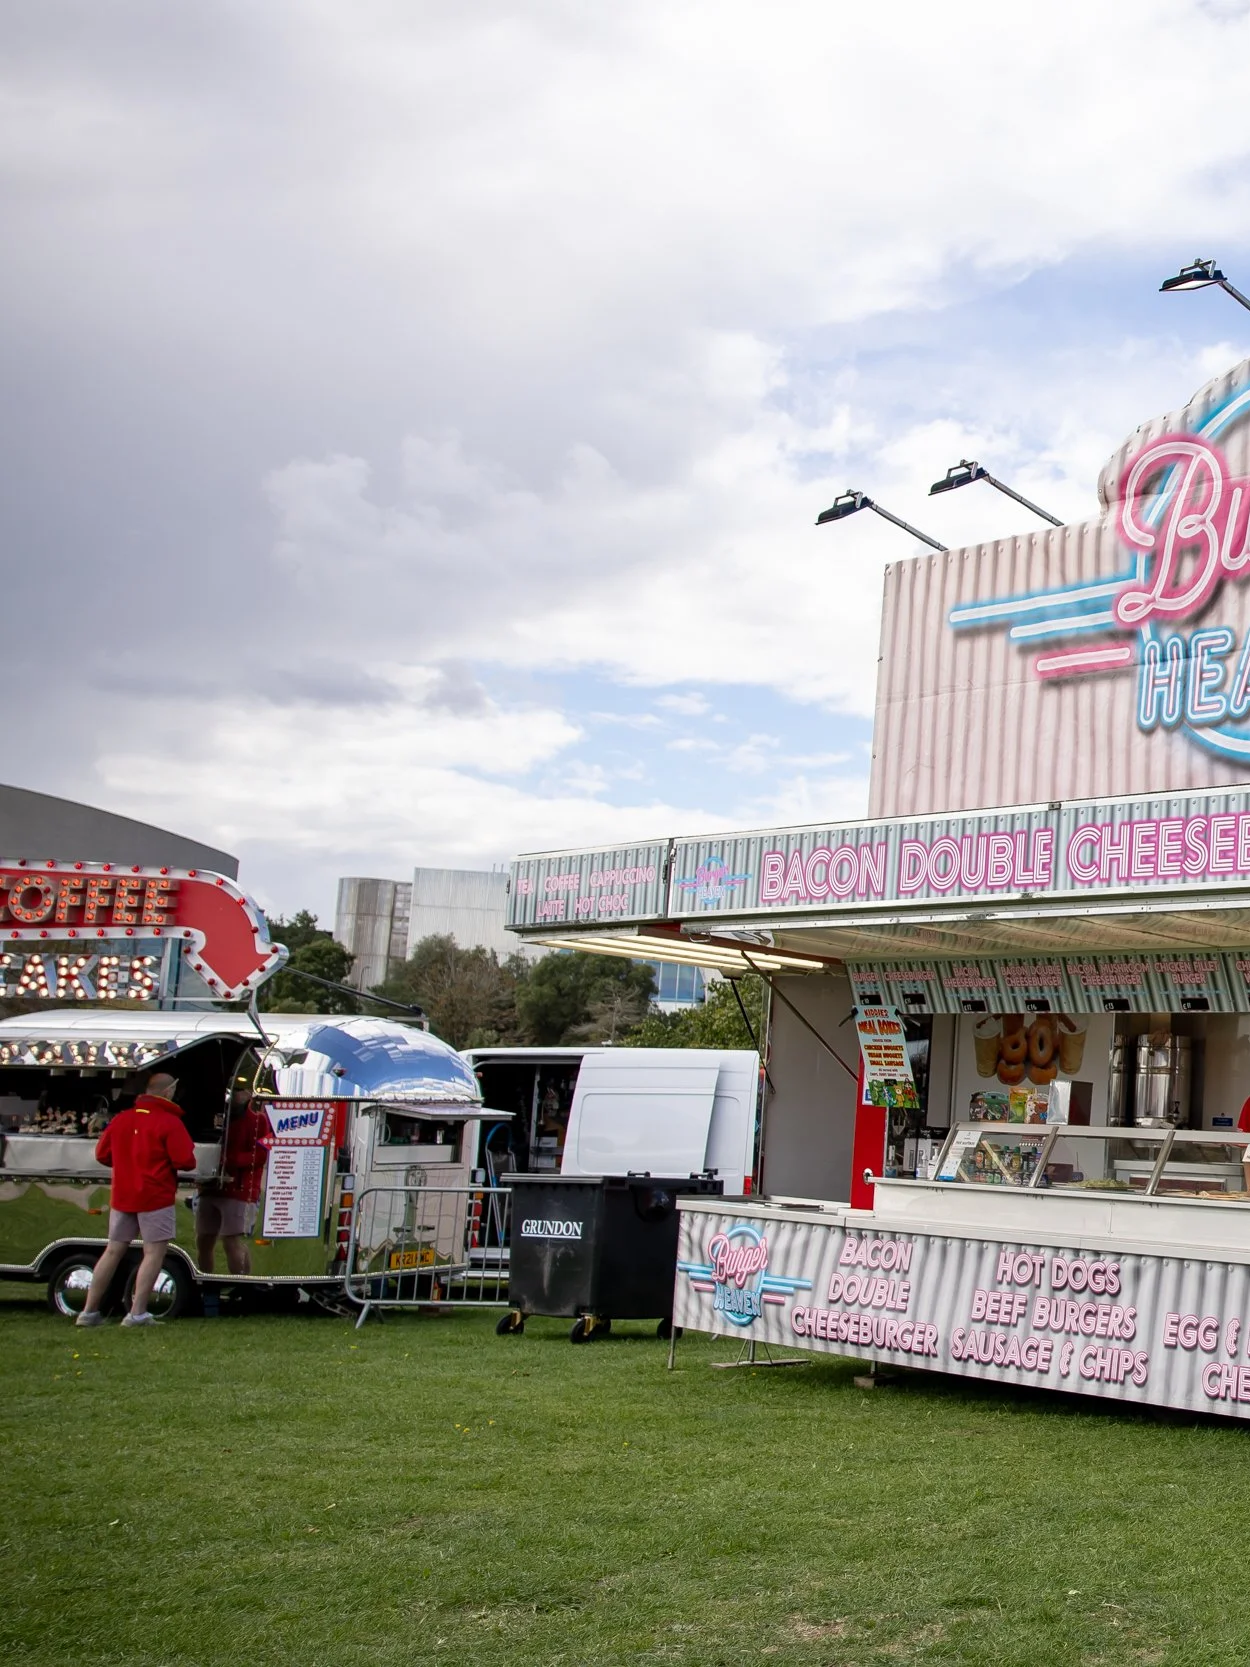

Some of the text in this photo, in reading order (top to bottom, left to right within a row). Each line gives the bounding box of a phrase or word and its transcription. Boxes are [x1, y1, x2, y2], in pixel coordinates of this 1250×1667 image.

[761, 842, 887, 901] BACON
[898, 828, 1053, 893] DOUBLE
[517, 865, 656, 895] TEA COFFEE CAPPUCCINO
[696, 864, 729, 884] Burger
[697, 885, 726, 899] HEAVEN
[536, 893, 628, 917] LATTE HOT CHOC
[884, 970, 936, 981] CHEESEBURGER
[952, 966, 980, 977] BACON
[1001, 965, 1063, 977] BACON DOUBLE
[1101, 962, 1150, 974] MUSHROOM
[1154, 960, 1219, 973] CHICKEN FILLET
[852, 972, 881, 982] BURGER
[943, 977, 997, 988] CHEESEBURGER
[1006, 976, 1063, 987] CHEESEBURGER
[1080, 973, 1143, 986] CHEESEBURGER
[1172, 973, 1206, 985] BURGER
[864, 1008, 889, 1018] KIDDIES
[858, 1020, 878, 1035] MEAL
[277, 1111, 319, 1133] MENU
[521, 1219, 584, 1236] GRUNDON
[708, 1232, 768, 1288] Burger
[839, 1237, 913, 1272] BACON
[996, 1251, 1121, 1295] HOT DOGS
[828, 1272, 910, 1311] DOUBLE
[713, 1287, 761, 1318] HEAVEN
[971, 1289, 1137, 1341] BEEF BURGERS
[791, 1305, 939, 1356] CHEESEBURGER
[1163, 1312, 1218, 1351] EGG
[1225, 1318, 1240, 1356] &
[951, 1327, 1149, 1385] SAUSAGE & CHIPS
